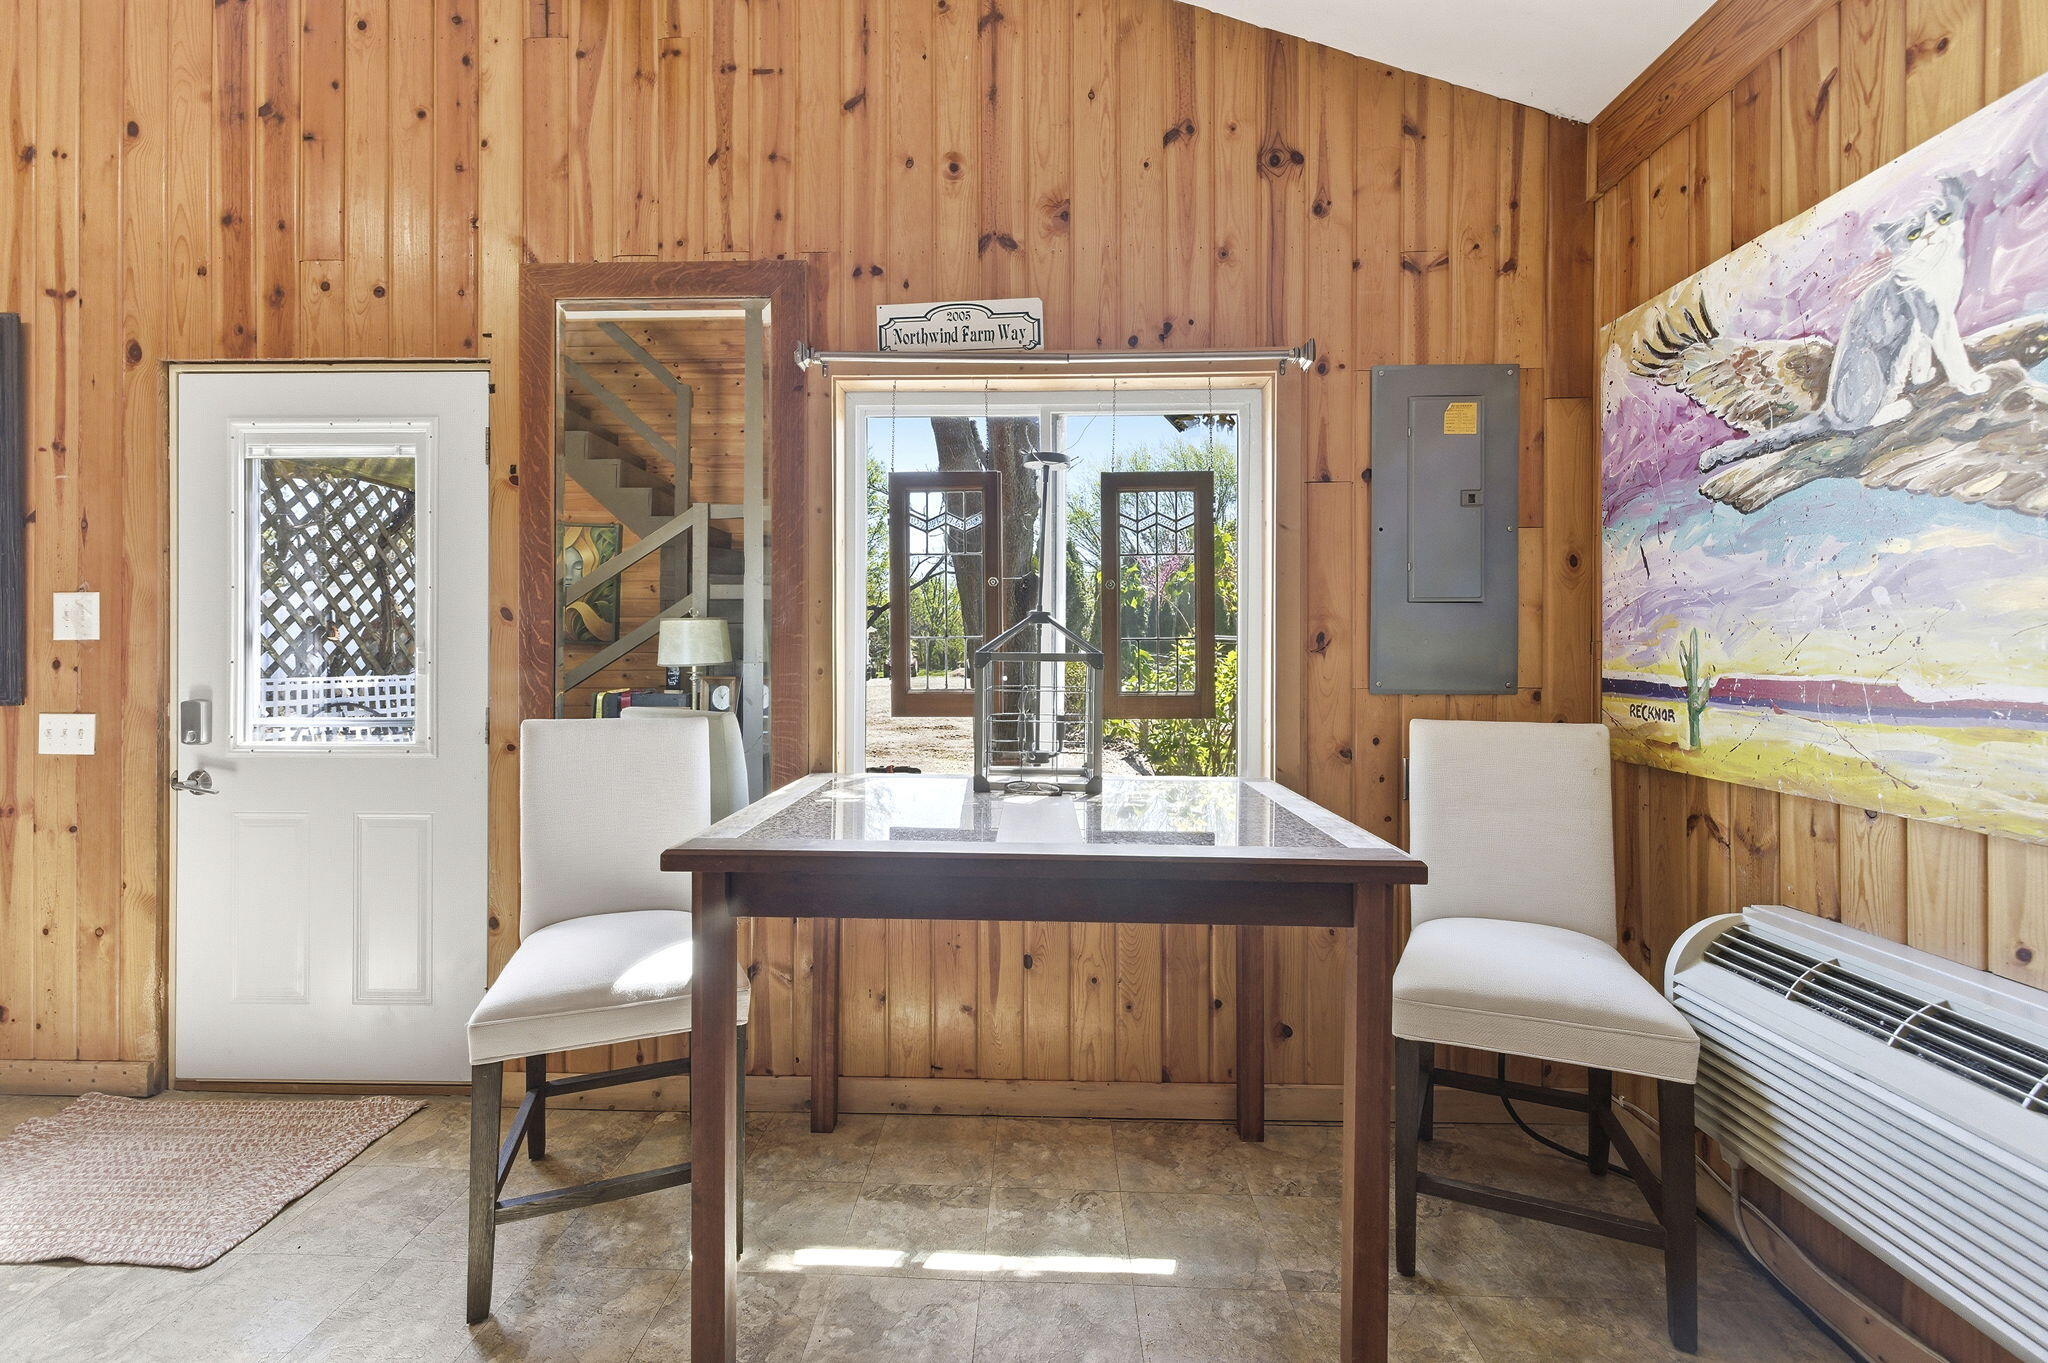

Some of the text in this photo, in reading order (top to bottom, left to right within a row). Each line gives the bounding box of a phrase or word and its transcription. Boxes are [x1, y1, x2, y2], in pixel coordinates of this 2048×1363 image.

[946, 311, 971, 322] 2005
[893, 323, 1027, 346] Northwind Farm Way
[1629, 703, 1676, 723] RECKNOR
